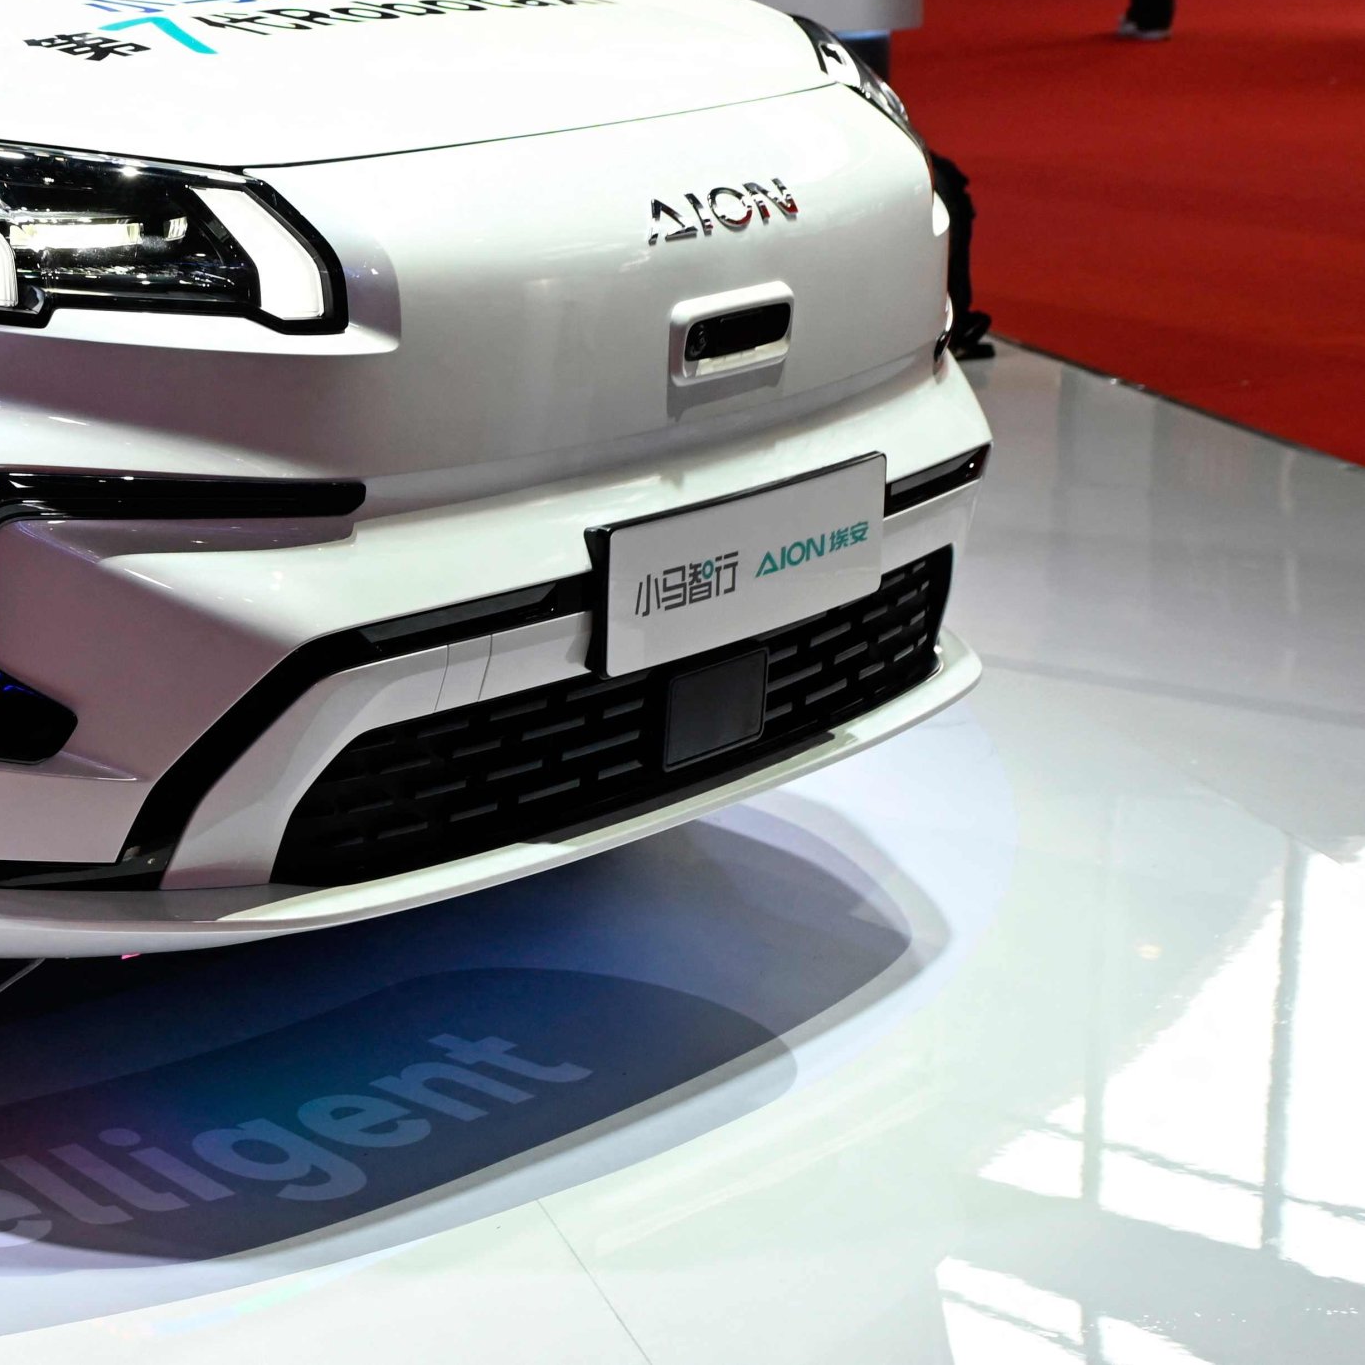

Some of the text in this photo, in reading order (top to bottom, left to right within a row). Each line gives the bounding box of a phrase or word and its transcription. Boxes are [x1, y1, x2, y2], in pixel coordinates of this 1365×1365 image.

[647, 176, 800, 247] AION
[634, 550, 740, 617] 小马智行
[755, 533, 827, 579] AION
